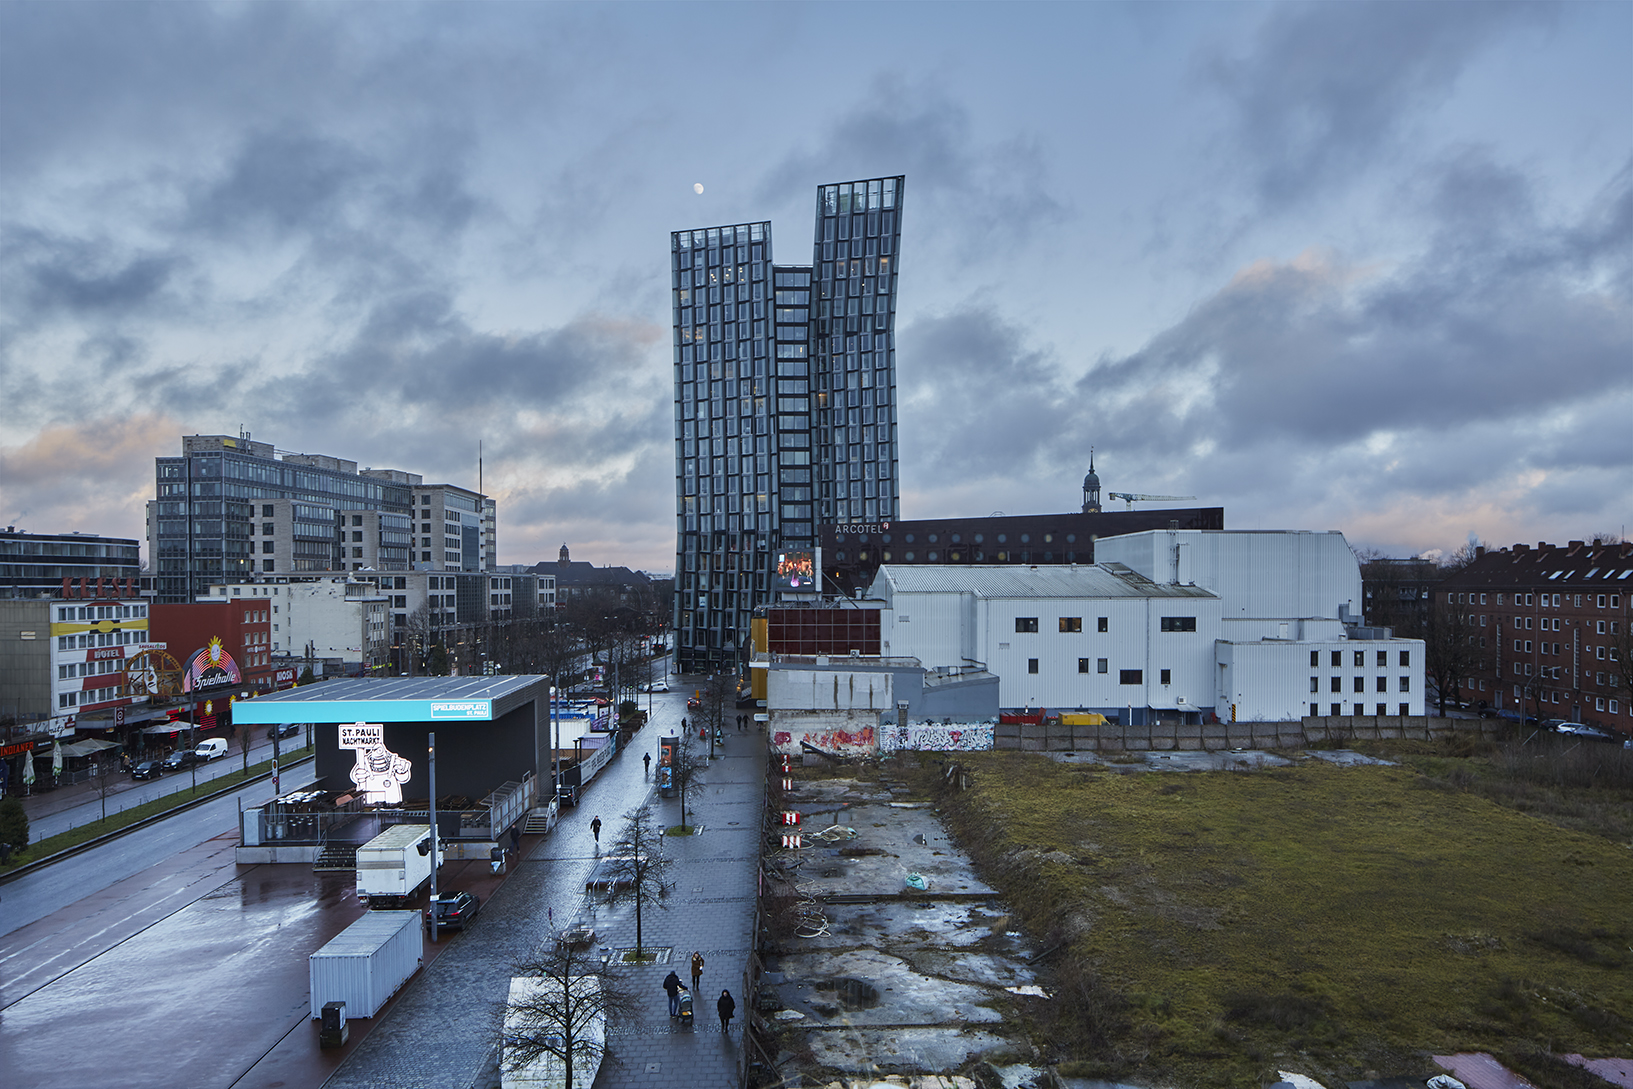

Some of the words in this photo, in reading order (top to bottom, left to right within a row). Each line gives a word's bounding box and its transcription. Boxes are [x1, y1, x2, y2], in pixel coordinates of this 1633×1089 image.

[835, 524, 883, 534] ARCOTEL
[94, 648, 120, 659] HOTEL
[194, 671, 236, 691] Spielhalle
[276, 669, 293, 682] KIOSK
[342, 737, 380, 745] NACHTMARKT
